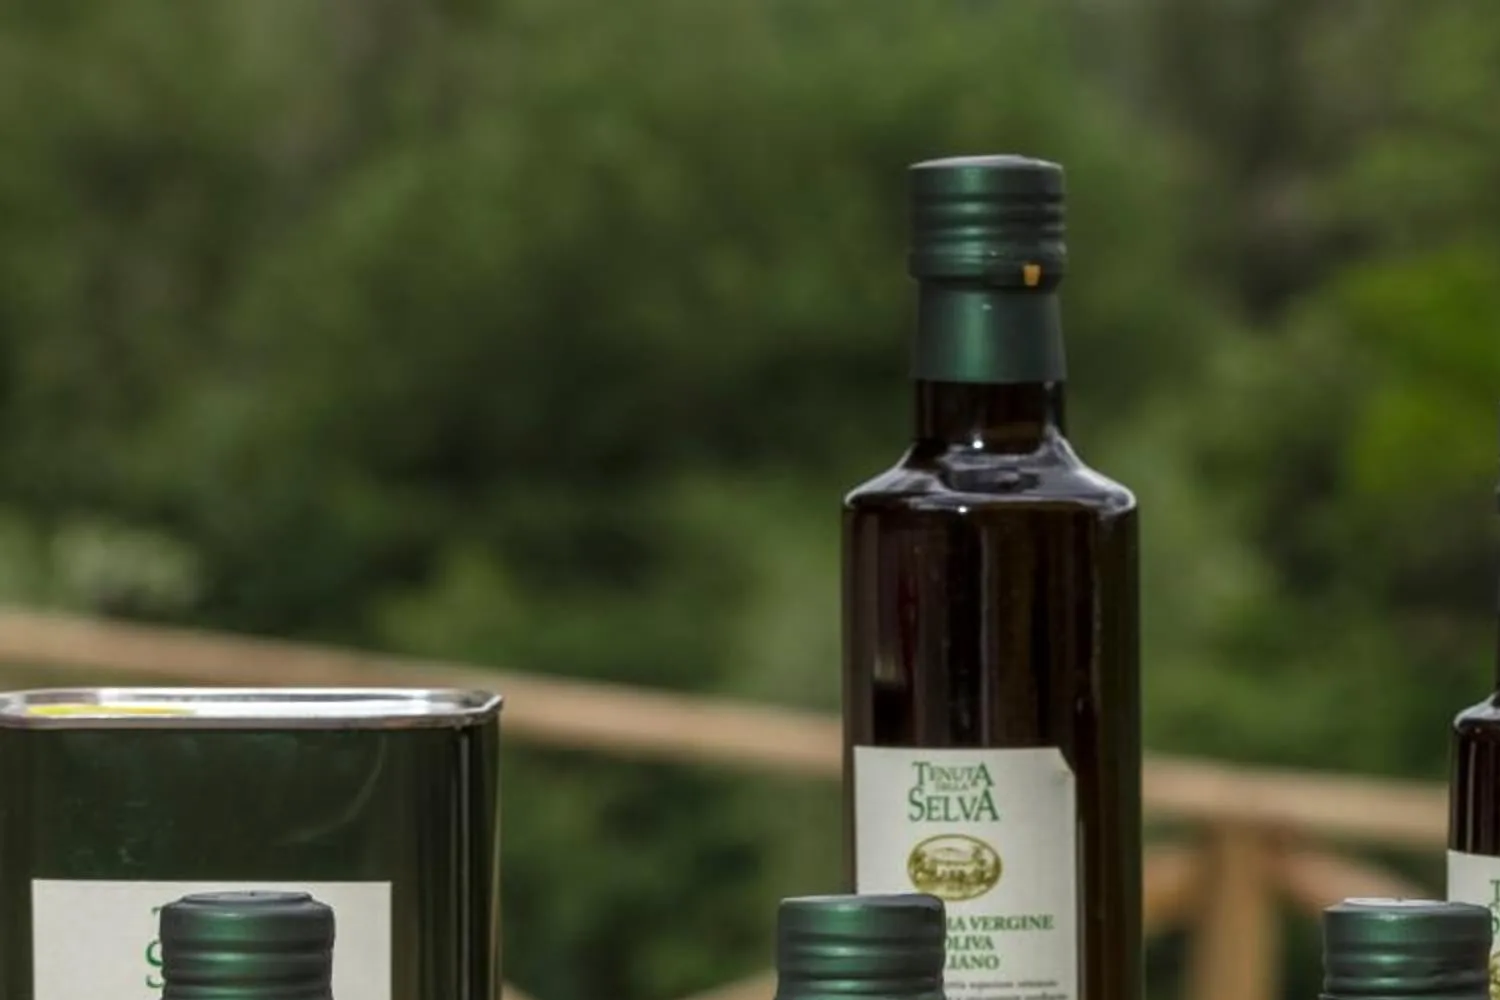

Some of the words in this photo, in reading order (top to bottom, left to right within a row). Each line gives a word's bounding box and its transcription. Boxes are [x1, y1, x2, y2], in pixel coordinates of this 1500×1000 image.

[912, 761, 994, 786] TENUTA
[908, 787, 999, 822] SELVA
[970, 914, 1054, 931] VERGINE
